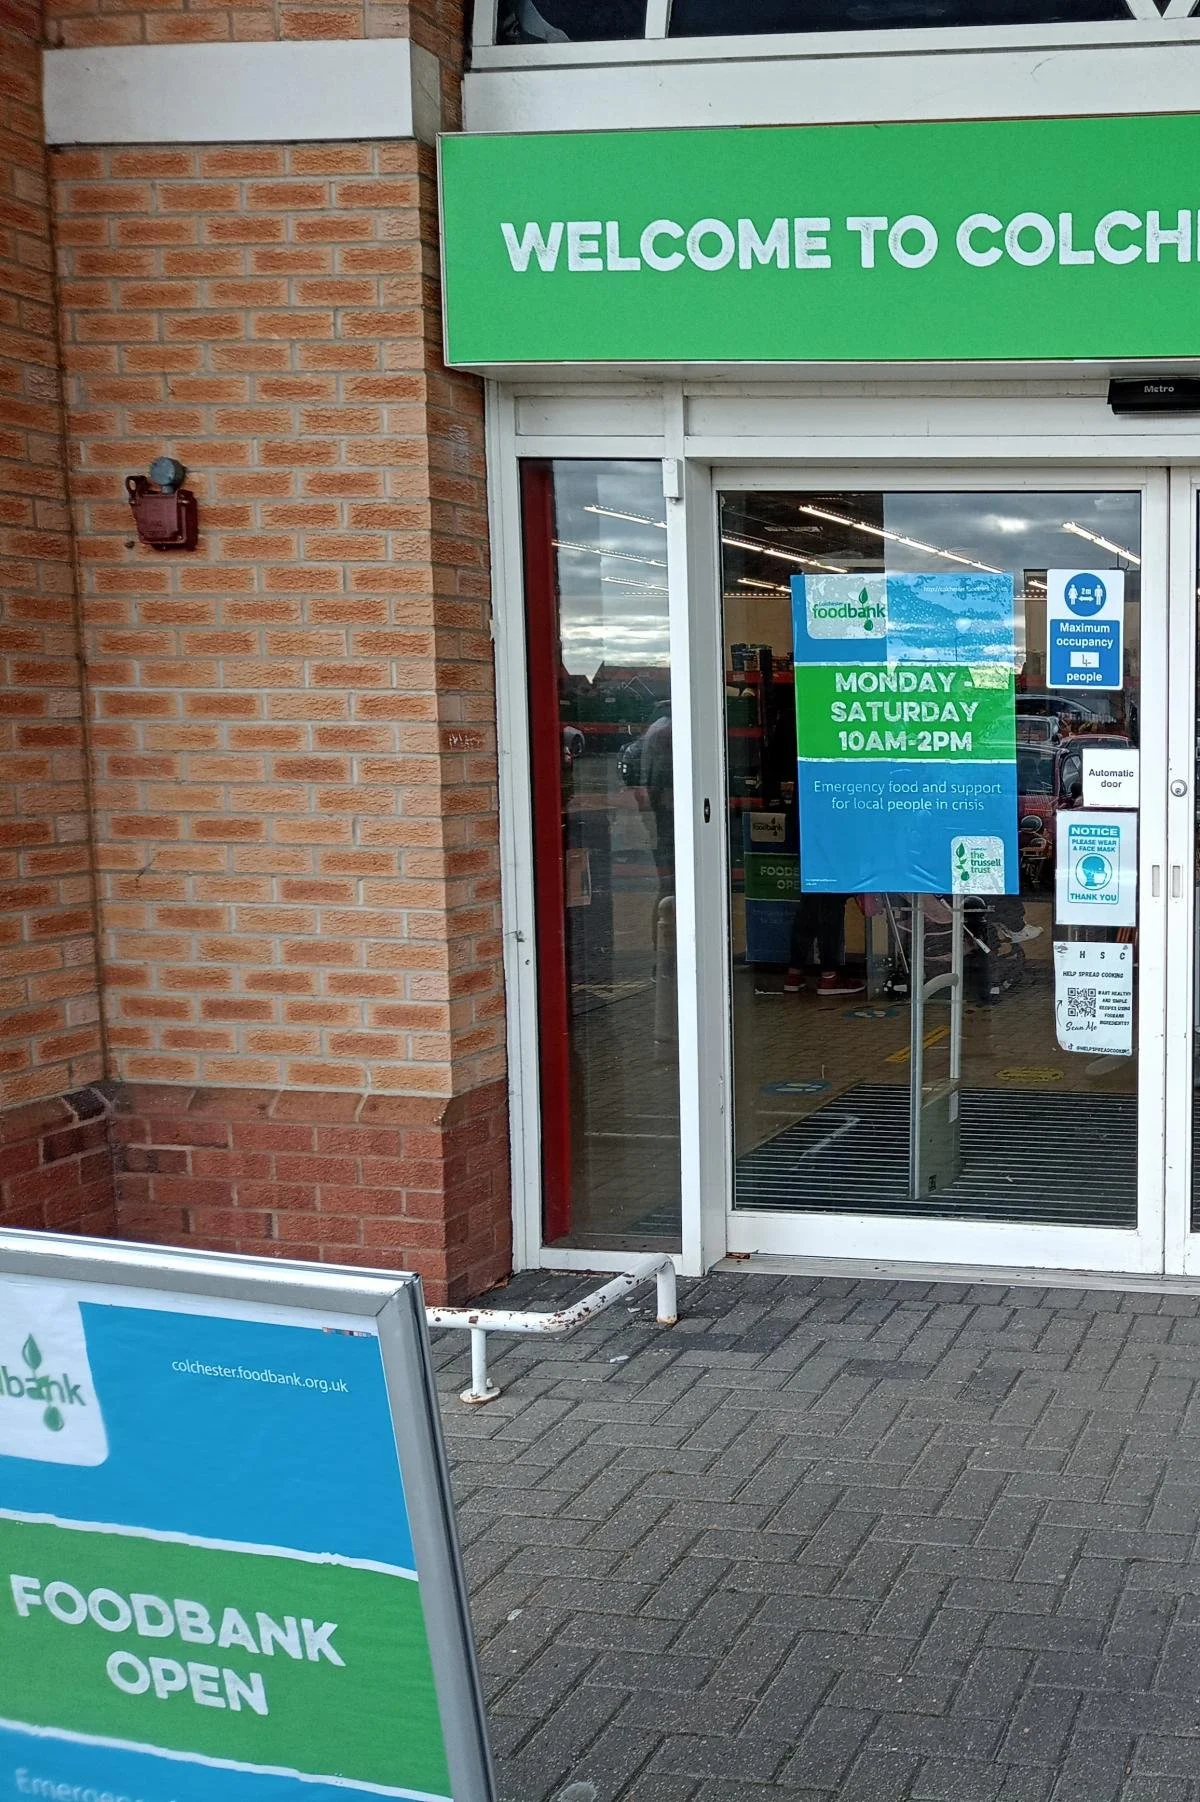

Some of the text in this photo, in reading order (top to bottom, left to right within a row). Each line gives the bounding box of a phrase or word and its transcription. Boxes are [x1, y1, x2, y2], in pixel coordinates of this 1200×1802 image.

[501, 217, 832, 272] WELCOME
[845, 214, 939, 269] TO
[1144, 385, 1175, 393] Metro
[1081, 587, 1092, 595] 2m
[812, 602, 886, 619] foodbank
[1060, 622, 1110, 633] Maximum
[1056, 637, 1113, 650] occupancy
[1081, 654, 1092, 667] 4
[835, 672, 957, 693] MONDAY
[1066, 672, 1103, 683] people
[831, 701, 979, 722] SATURDAY
[838, 731, 973, 751] 10AM-2PM
[1088, 768, 1134, 778] Automatic
[814, 780, 1002, 797] Emergency food and support
[1100, 780, 1122, 788] door
[832, 796, 985, 812] for local people in crisis
[1071, 826, 1119, 836] NOTICE
[1072, 838, 1117, 847] PLEASE WEAR
[970, 850, 985, 859] the
[970, 858, 1001, 867] trussell
[760, 866, 800, 877] FOODB
[777, 880, 800, 889] OPE
[1070, 893, 1117, 902] THANK YOU
[1079, 950, 1126, 960] H S C
[1065, 1021, 1098, 1032] Scan Me
[171, 1359, 349, 1393] colchester.foodbank.org.uk
[9, 1573, 347, 1668] FOODBANK
[106, 1650, 270, 1716] OPEN
